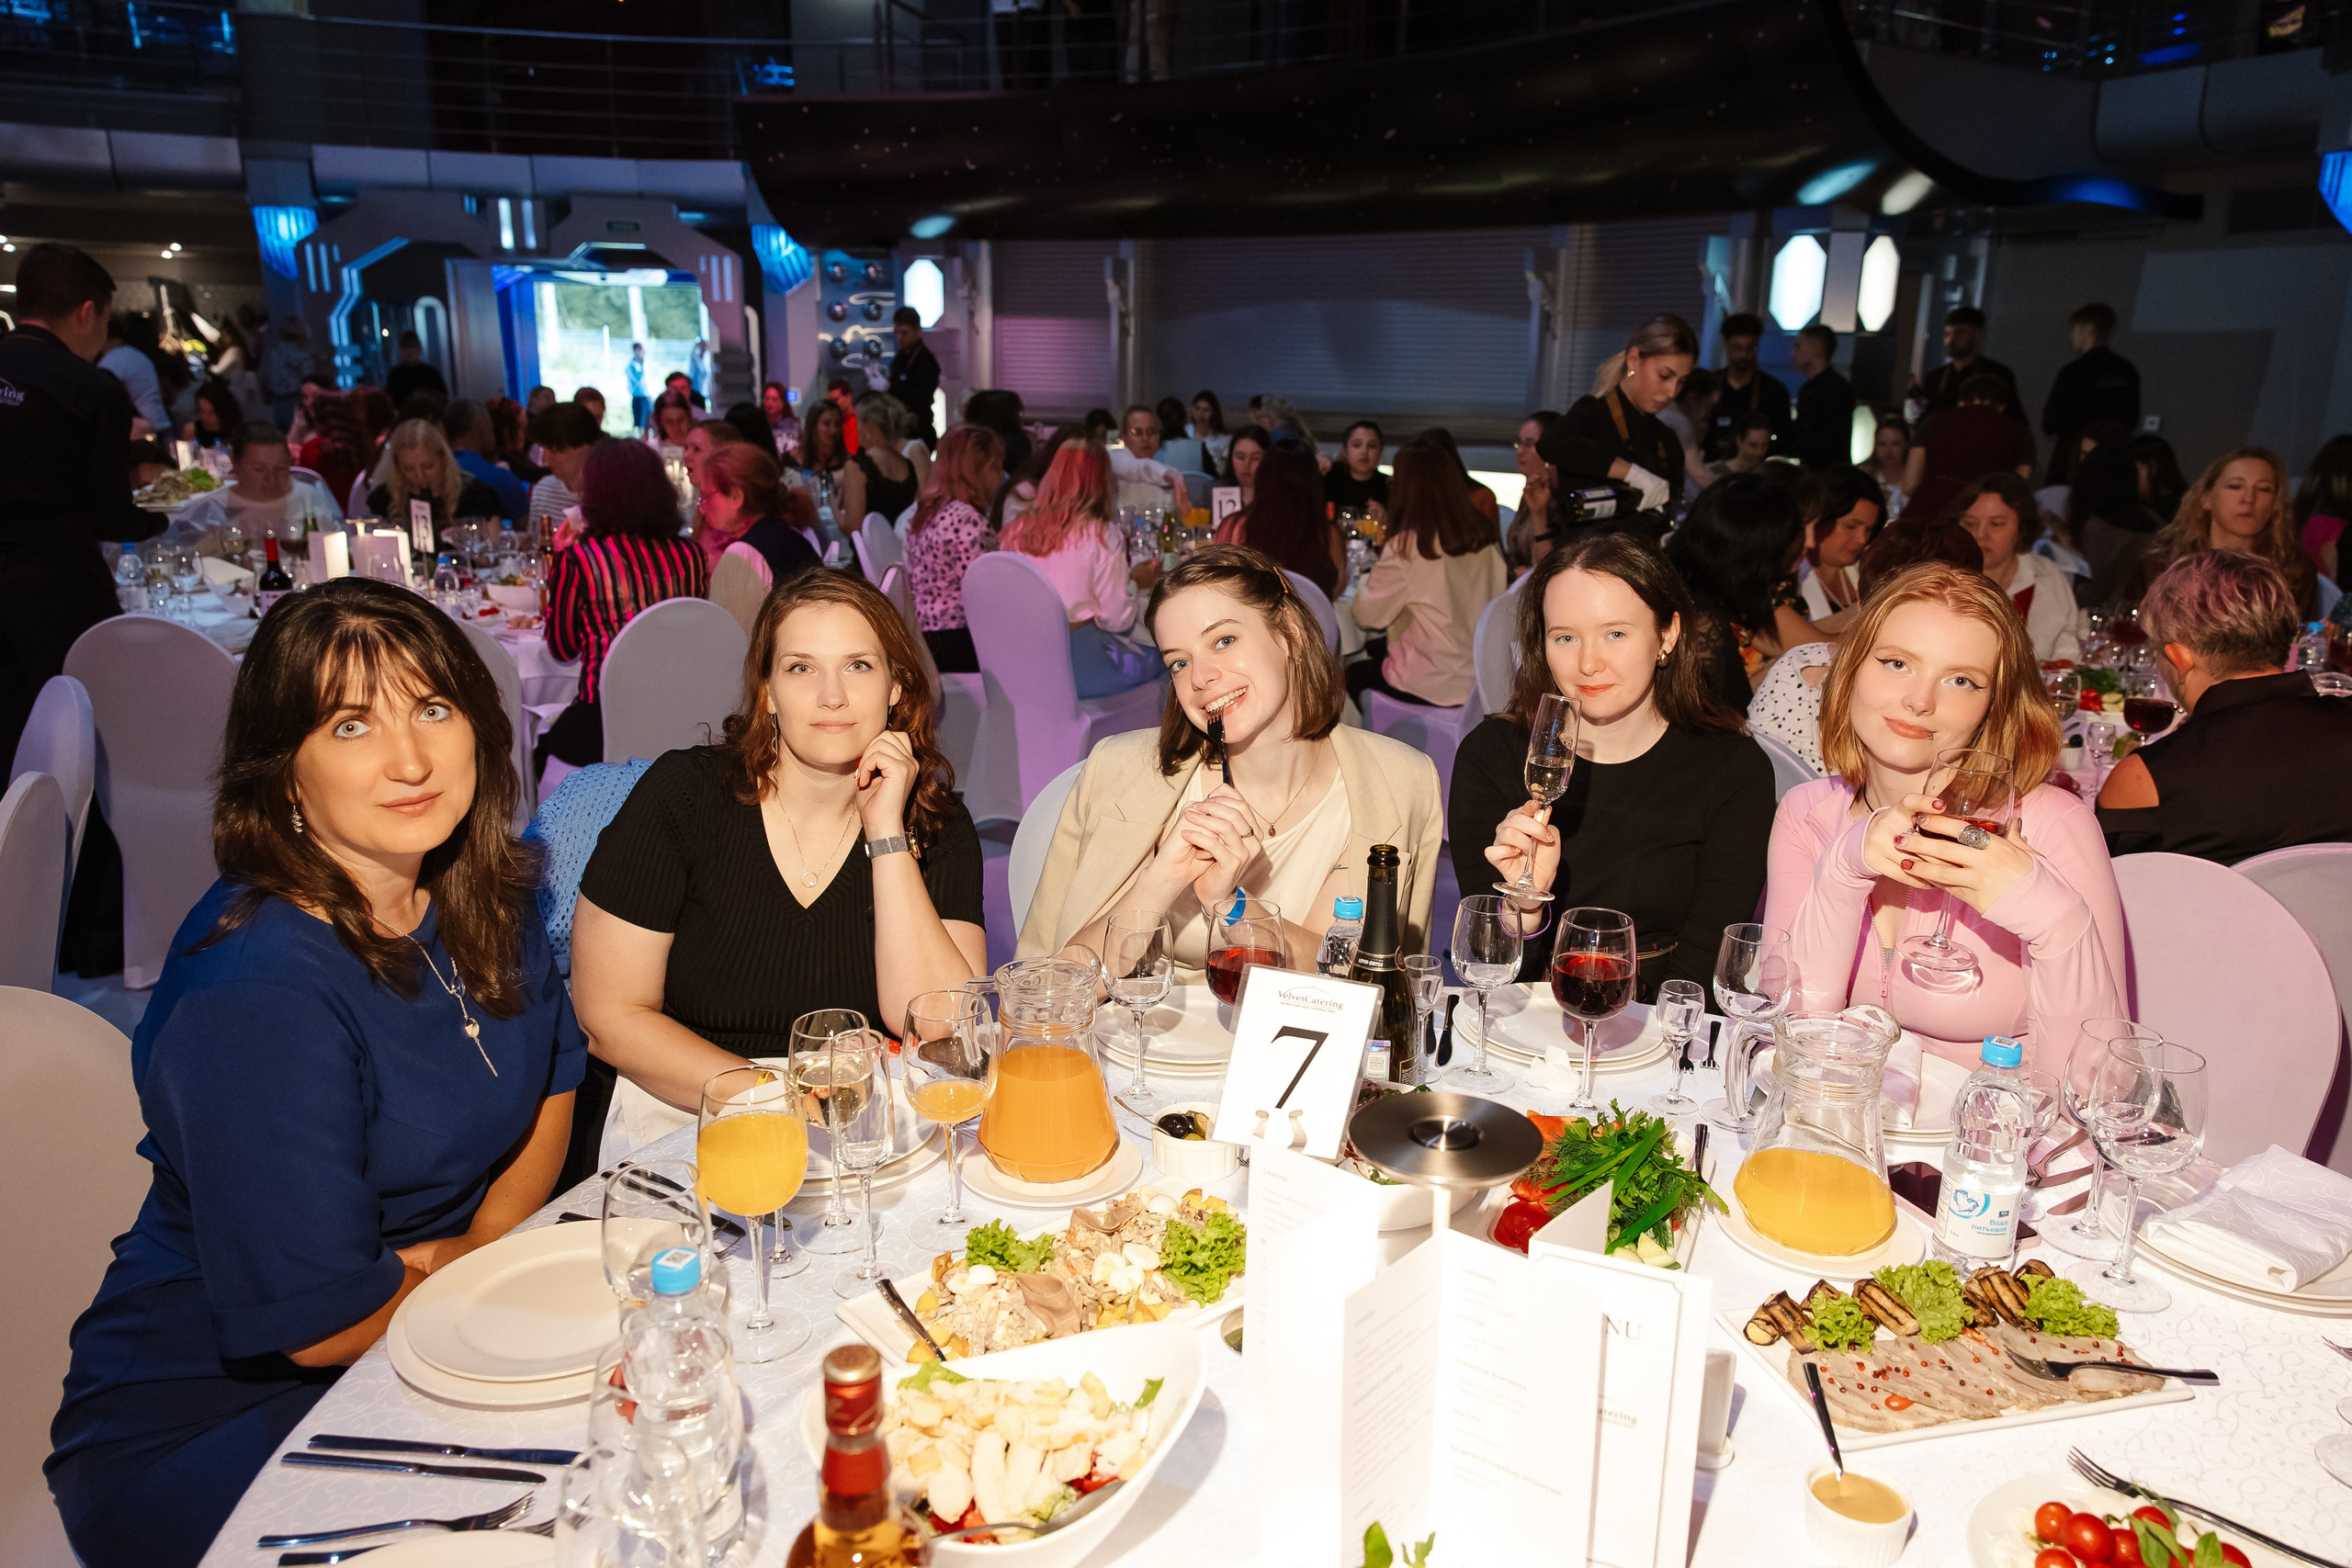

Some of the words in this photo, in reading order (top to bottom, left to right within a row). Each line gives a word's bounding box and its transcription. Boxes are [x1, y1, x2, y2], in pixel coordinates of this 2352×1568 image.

[1278, 990, 1343, 1010] VelvetCatering
[1271, 1025, 1329, 1109] 7
[1972, 1224, 2007, 1233] питьевая
[1605, 1314, 1642, 1340] NU
[1598, 1408, 1638, 1426] atering
